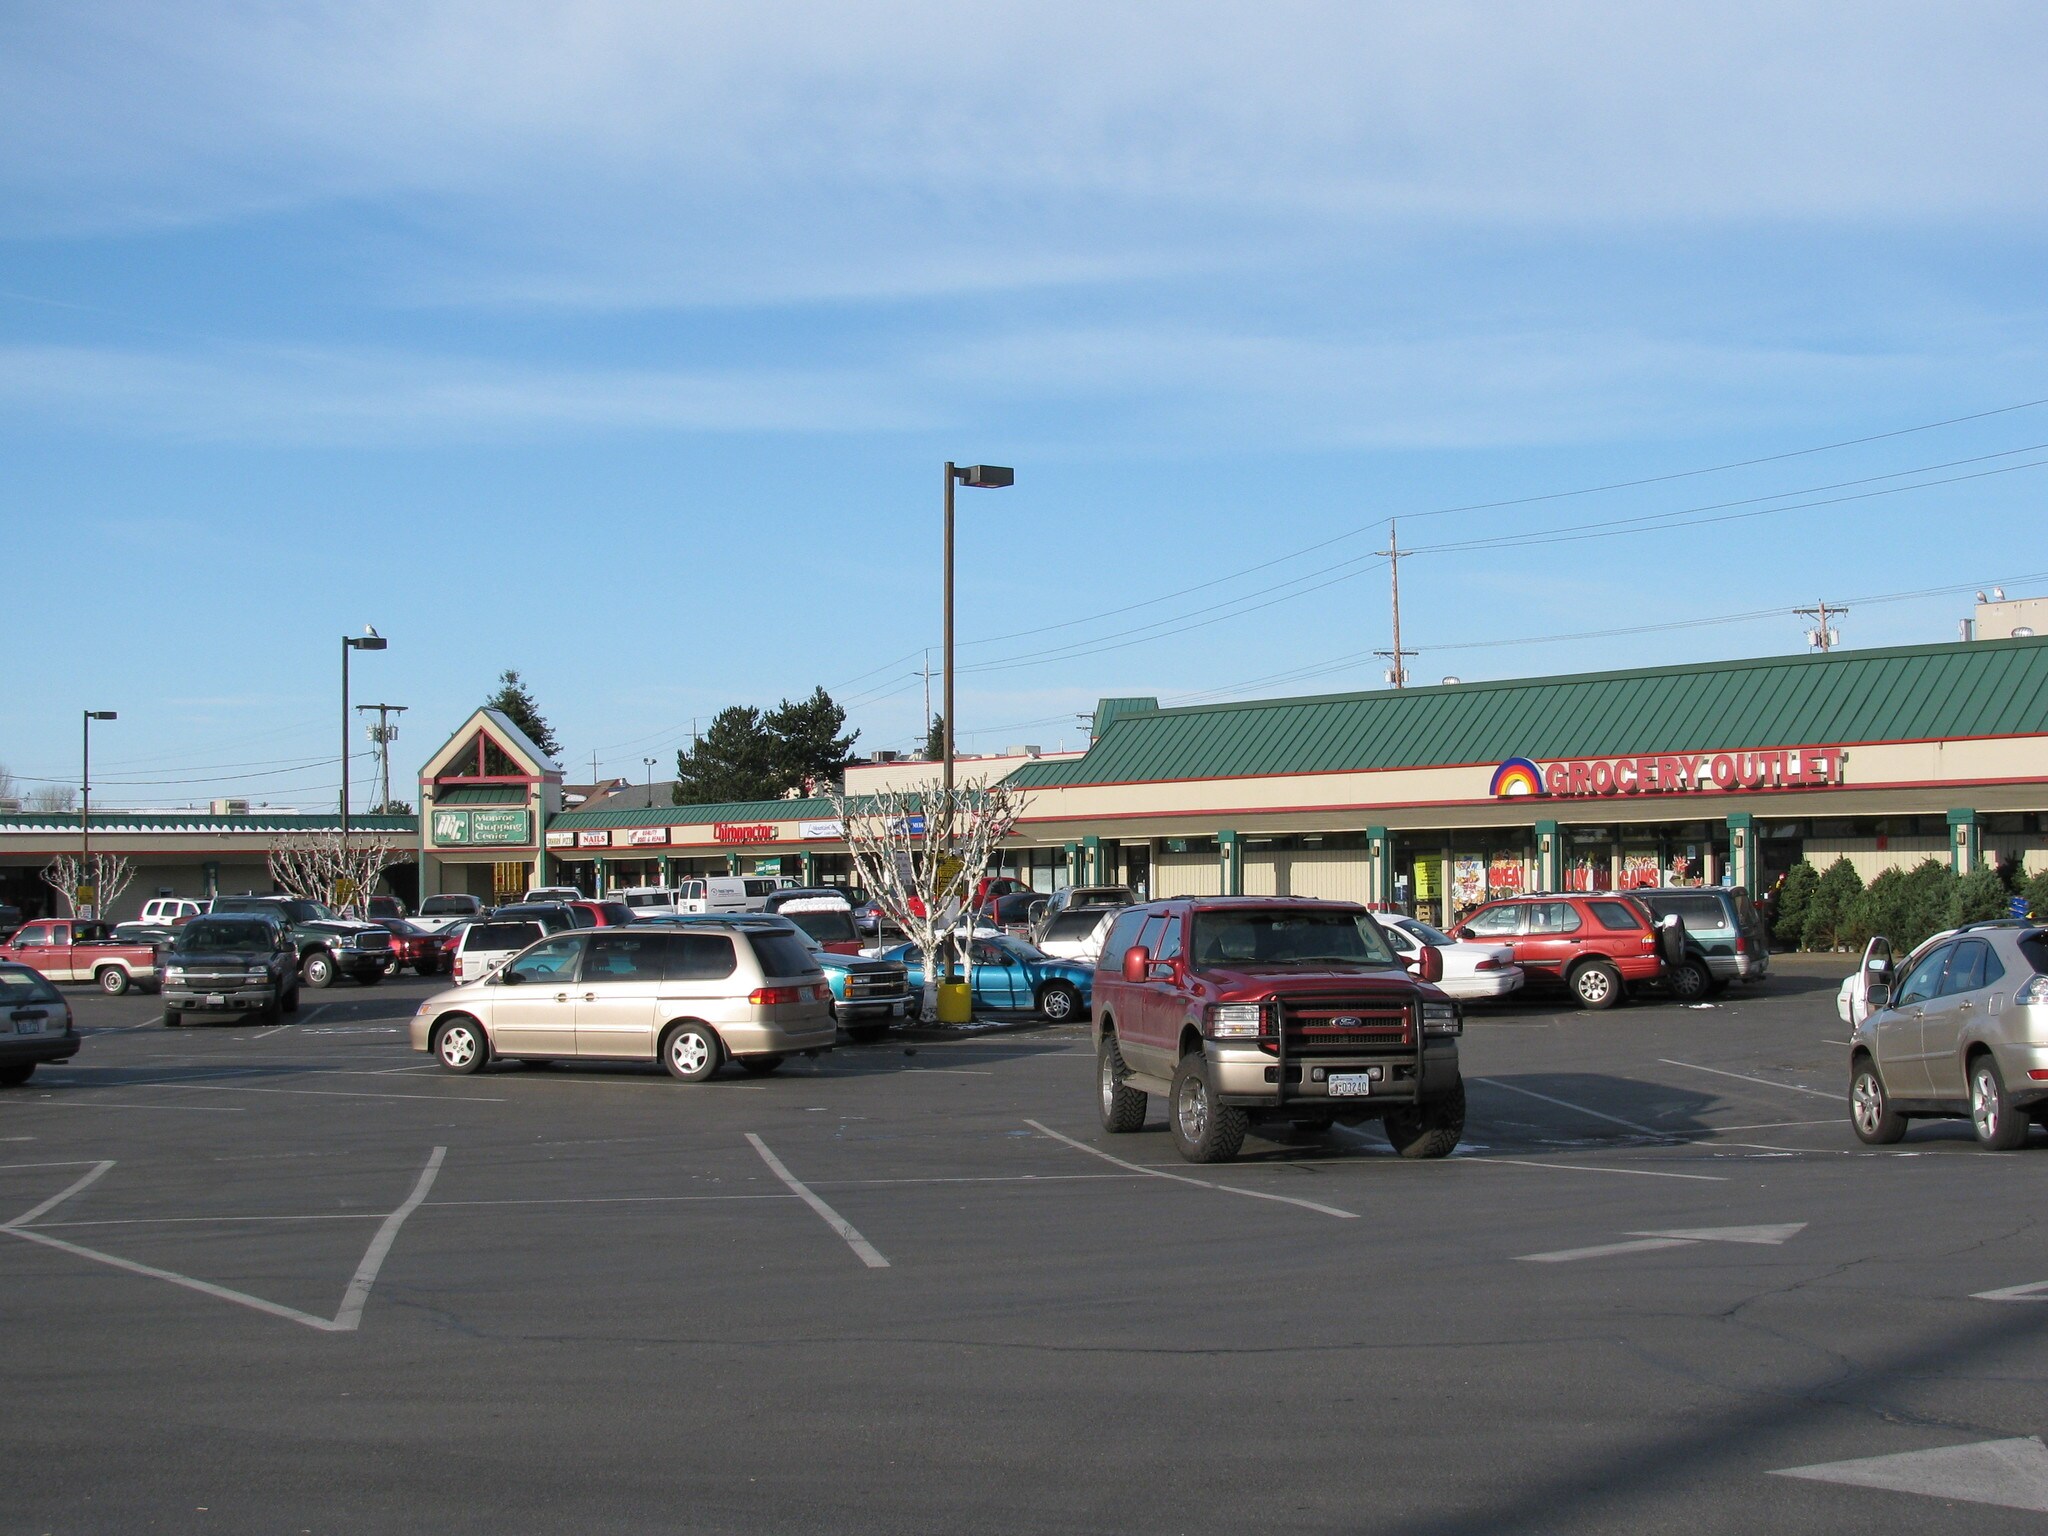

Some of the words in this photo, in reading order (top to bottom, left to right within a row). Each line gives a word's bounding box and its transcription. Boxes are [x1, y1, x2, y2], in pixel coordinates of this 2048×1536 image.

[1546, 756, 1703, 795] GROCERY
[1710, 749, 1844, 789] OUTLET
[475, 814, 515, 822] Monroe
[475, 822, 523, 832] Shopping
[713, 823, 773, 840] Chiropractor
[475, 832, 509, 840] Center
[583, 835, 606, 843] NAILS
